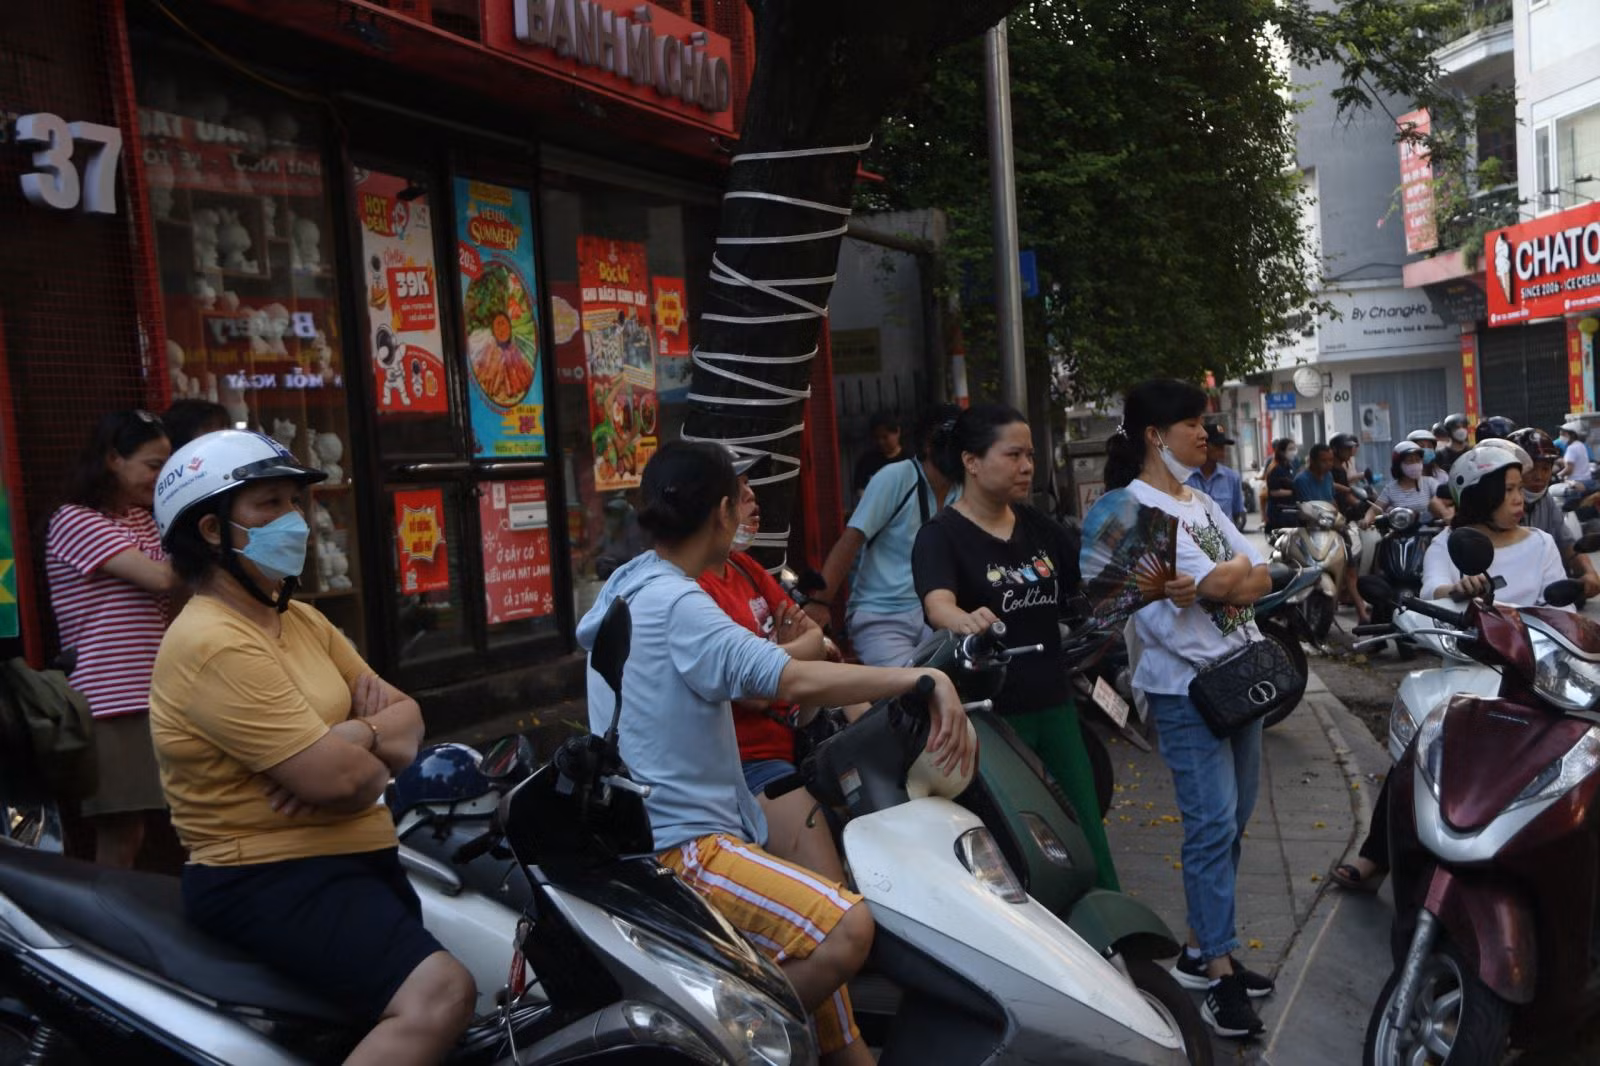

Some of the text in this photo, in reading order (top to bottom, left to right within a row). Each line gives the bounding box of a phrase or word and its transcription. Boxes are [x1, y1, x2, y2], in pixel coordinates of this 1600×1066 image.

[15, 111, 122, 215] 37
[363, 194, 389, 217] HOT
[366, 214, 390, 234] DEAL
[1515, 221, 1600, 281] CHATO
[1520, 284, 1541, 299] SINCE
[1541, 281, 1560, 297] 2006
[1563, 277, 1576, 291] ICE
[1352, 307, 1367, 321] By
[1369, 302, 1428, 319] ChangHo
[1386, 326, 1402, 336] Style
[1334, 389, 1350, 402] 60
[158, 465, 184, 497] BIDV
